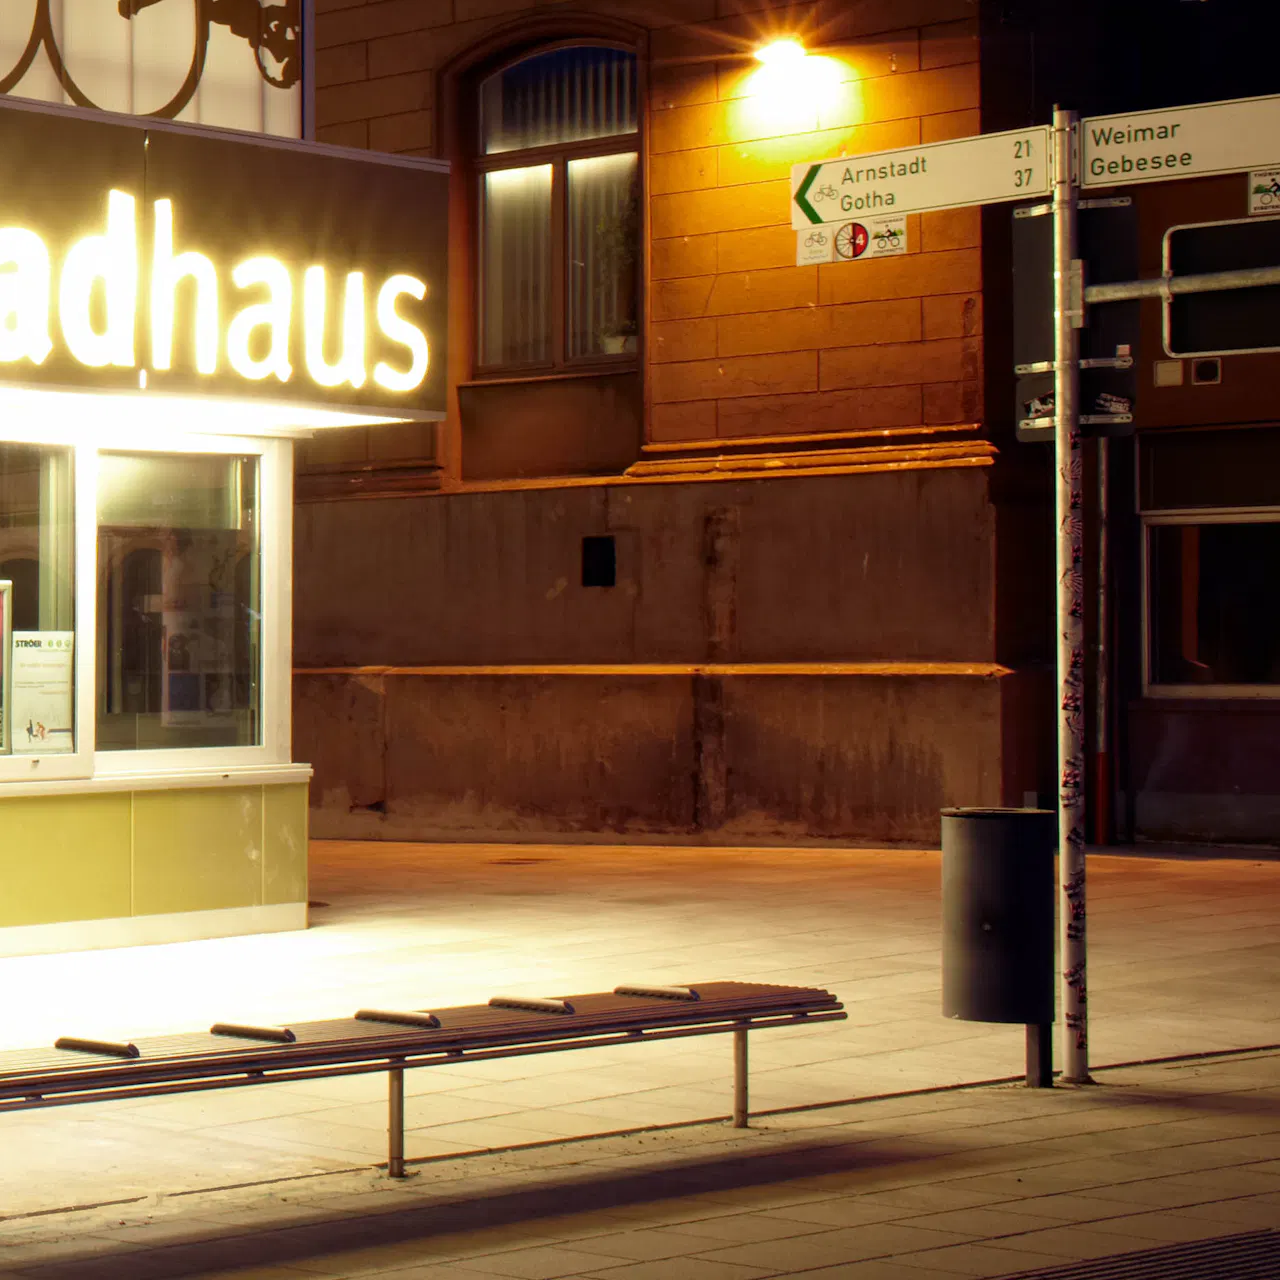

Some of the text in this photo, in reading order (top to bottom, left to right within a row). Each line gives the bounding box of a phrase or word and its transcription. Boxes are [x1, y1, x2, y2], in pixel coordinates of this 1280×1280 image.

[1092, 124, 1181, 147] Weimar
[841, 140, 1032, 185] Arnstadt 21
[1090, 152, 1192, 176] Gebesee
[840, 168, 1033, 212] Gotha 37
[855, 234, 864, 246] 4
